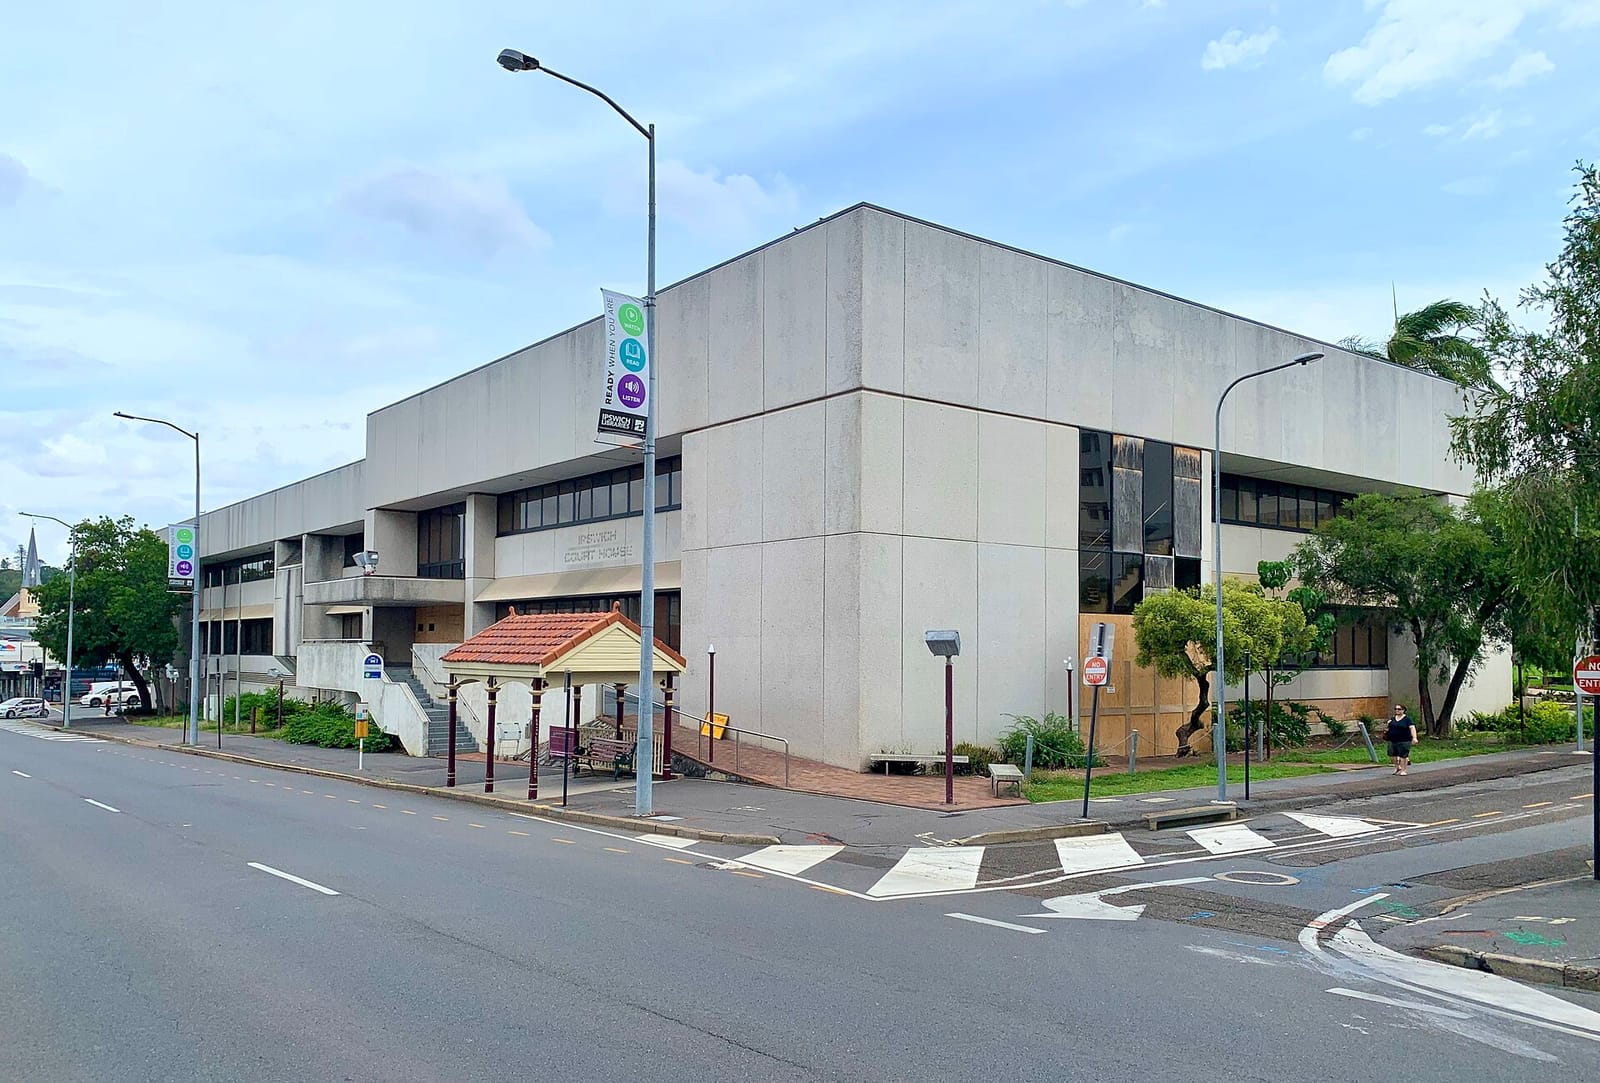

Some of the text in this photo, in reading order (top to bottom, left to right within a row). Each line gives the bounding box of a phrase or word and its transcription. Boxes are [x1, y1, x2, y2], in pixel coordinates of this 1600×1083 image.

[624, 323, 641, 332] WATCH
[605, 297, 616, 405] READY WHEN YOU ARE
[626, 358, 640, 367] READ
[622, 394, 641, 403] LISTEN
[602, 413, 631, 425] IPSWICH
[578, 530, 617, 544] IPSWICH
[564, 545, 632, 563] COURT HOUSE
